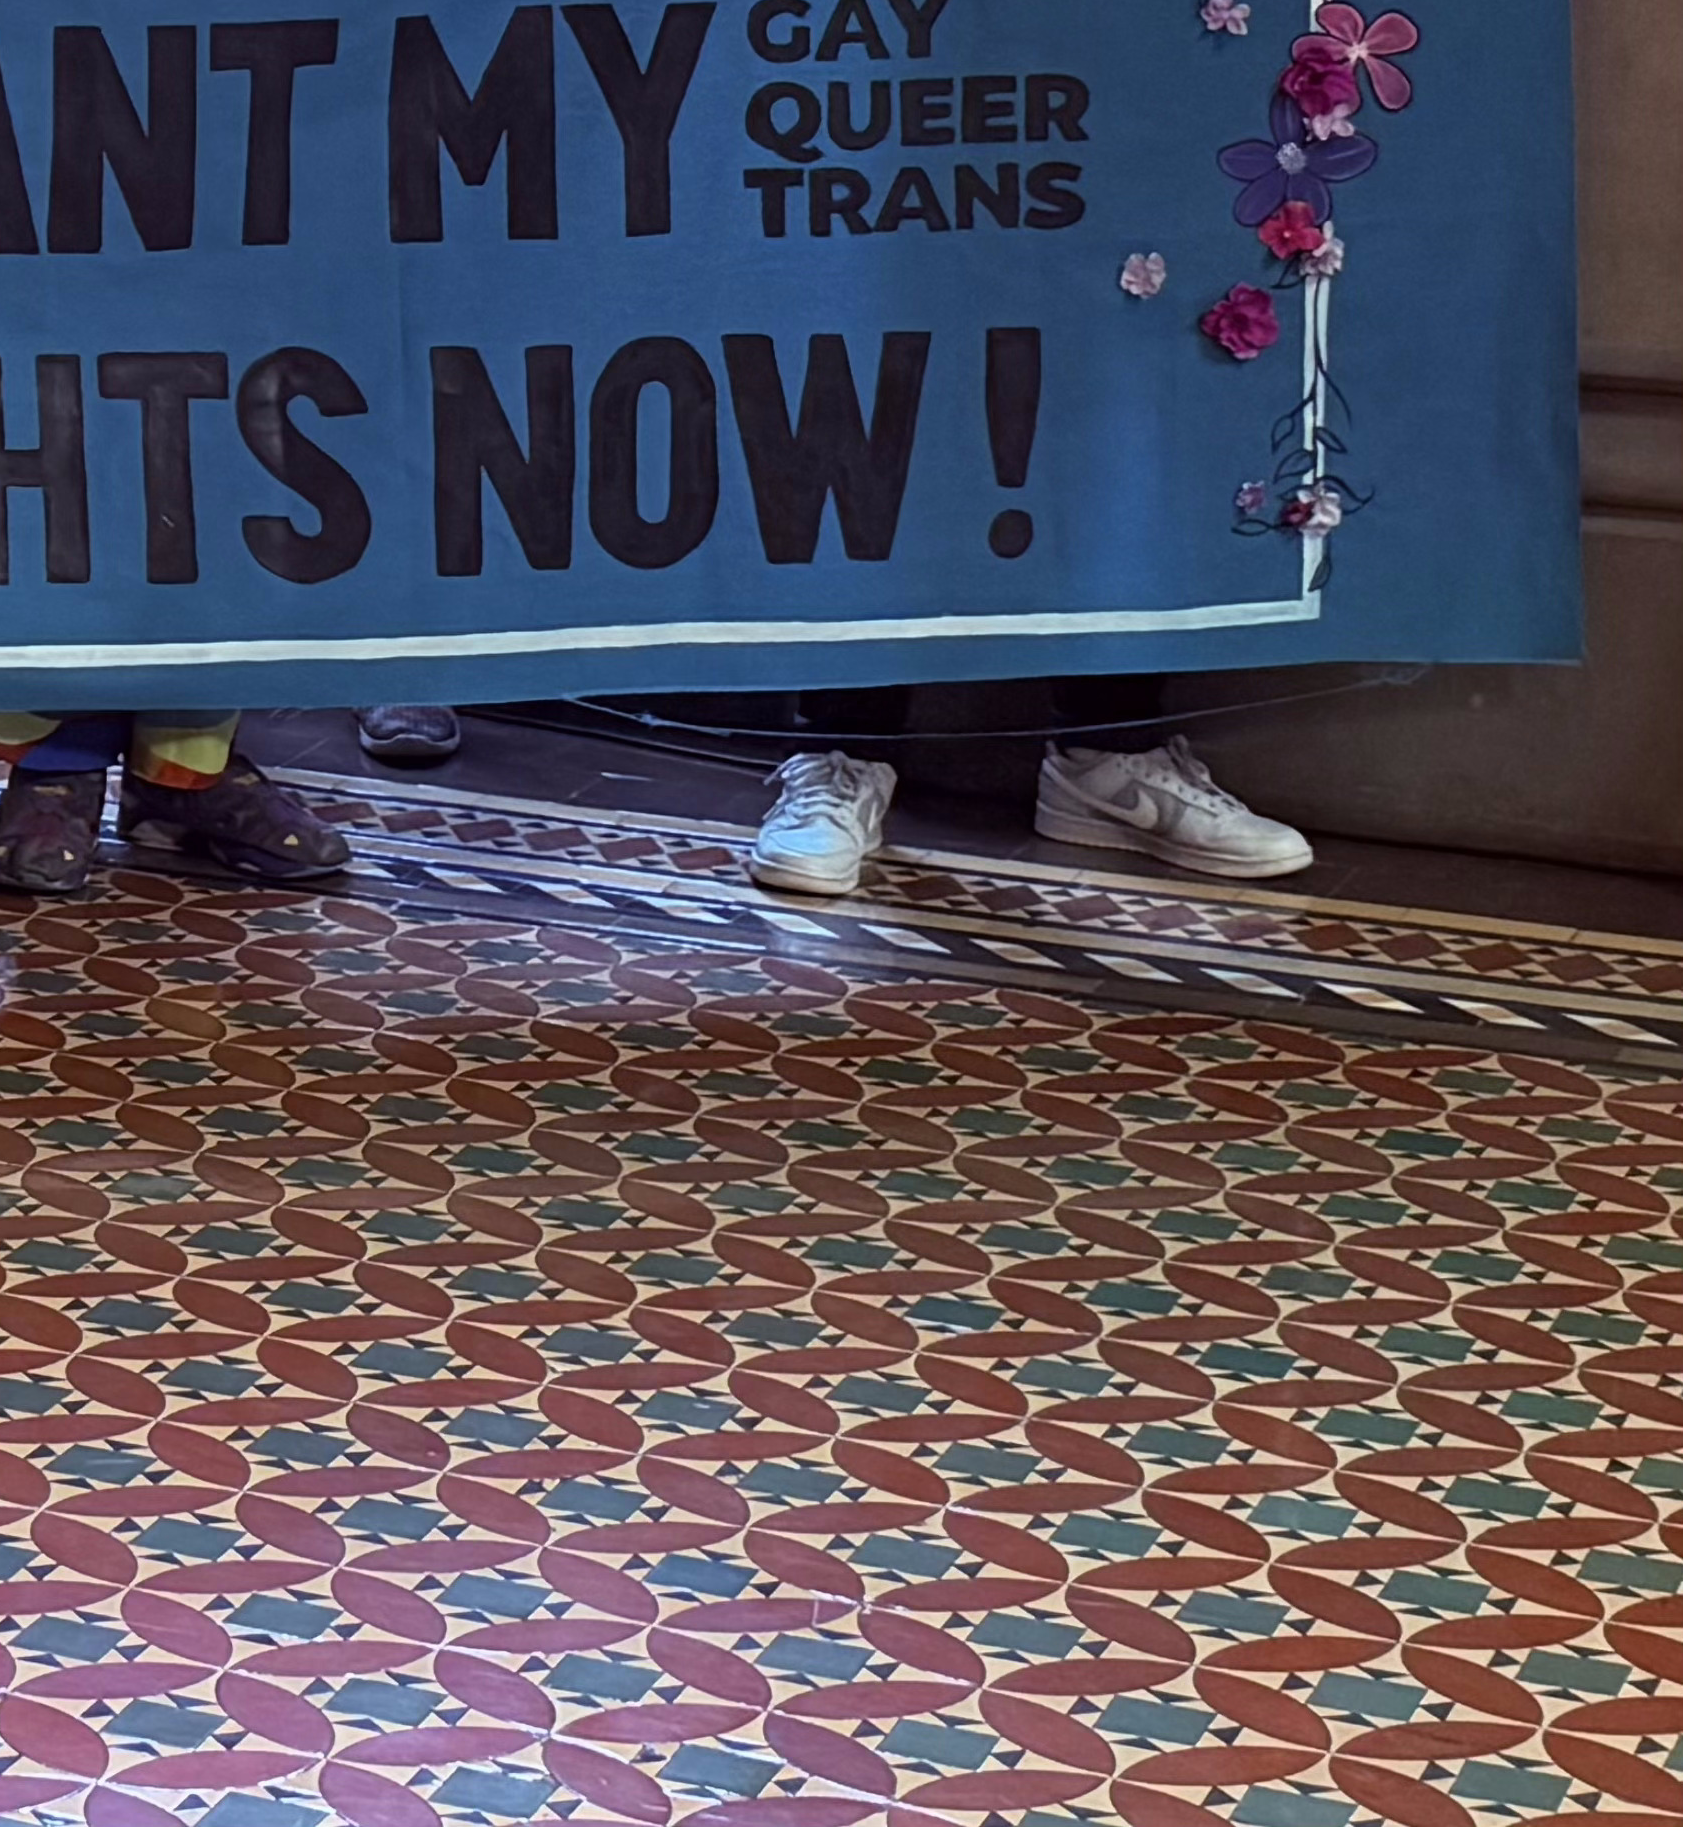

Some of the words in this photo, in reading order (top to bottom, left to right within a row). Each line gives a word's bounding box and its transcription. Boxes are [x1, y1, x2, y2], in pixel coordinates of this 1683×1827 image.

[387, 1, 718, 244] MY
[744, 72, 1091, 161] QUEER
[743, 161, 1087, 238] TRANS
